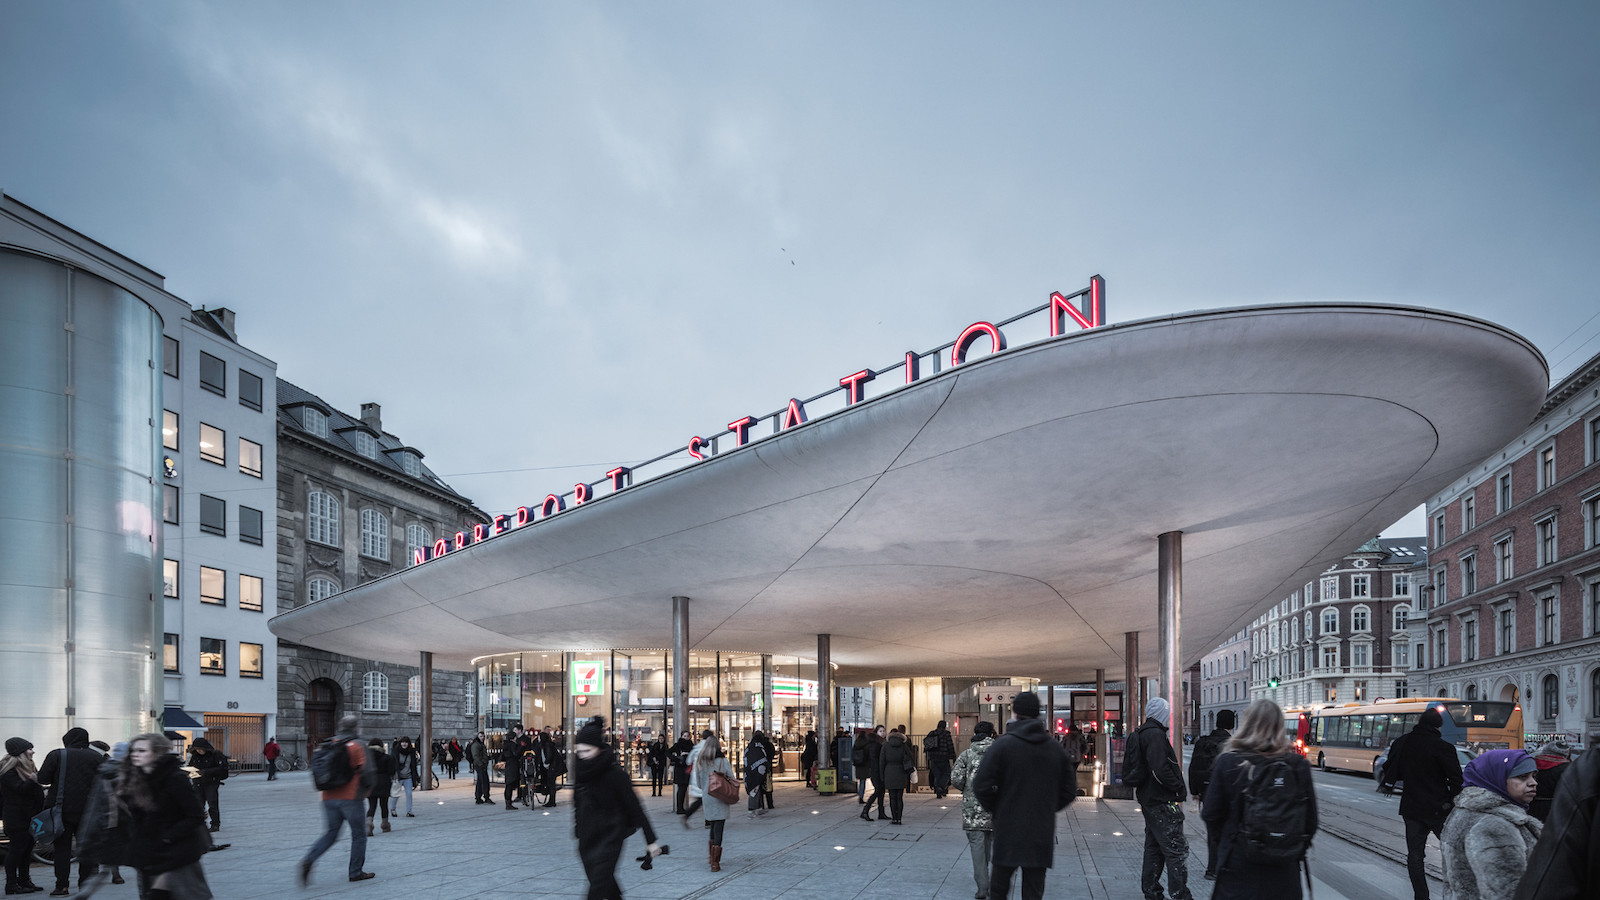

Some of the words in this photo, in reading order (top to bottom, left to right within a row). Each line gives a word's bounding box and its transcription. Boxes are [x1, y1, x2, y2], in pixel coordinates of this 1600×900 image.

[414, 466, 628, 565] NØRREPORT
[688, 274, 1105, 461] STATION
[226, 701, 239, 709] 80
